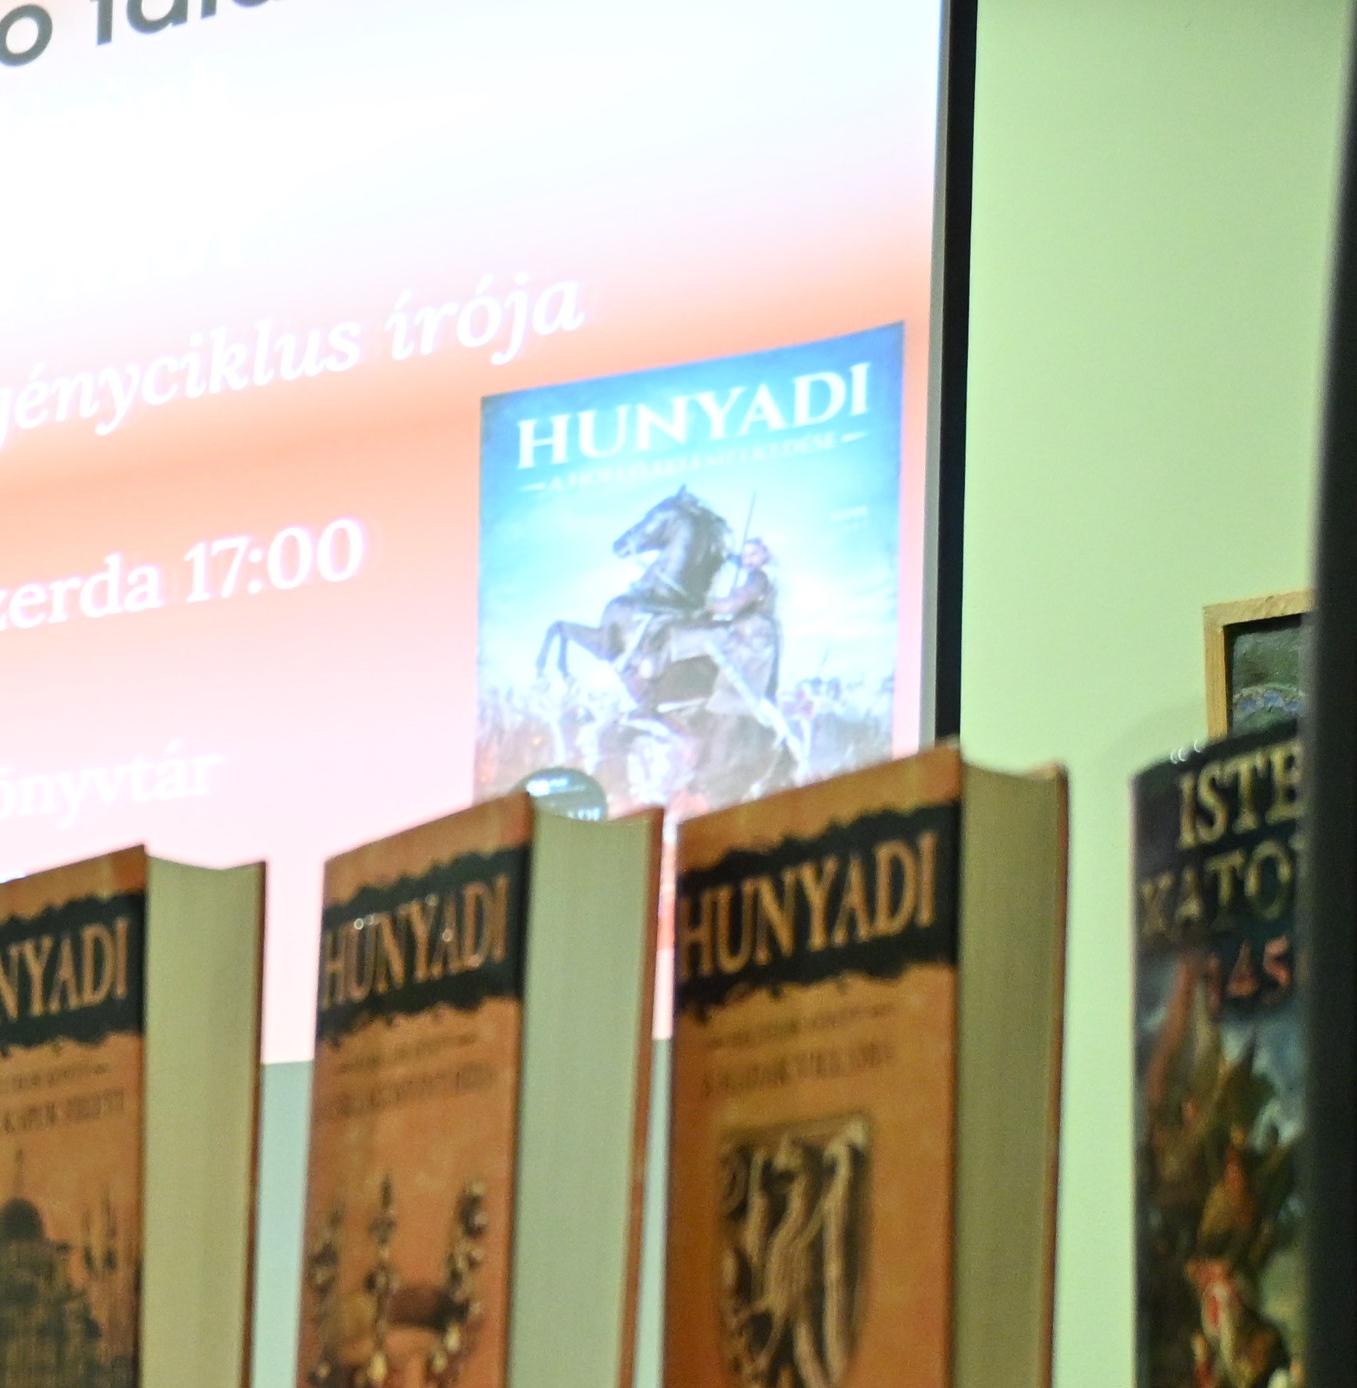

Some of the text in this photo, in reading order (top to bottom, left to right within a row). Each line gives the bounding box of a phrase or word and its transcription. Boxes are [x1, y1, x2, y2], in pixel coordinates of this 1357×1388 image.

[384, 272, 585, 365] írója
[517, 362, 871, 470] HUNYADI
[183, 517, 366, 604] 17:00
[323, 873, 511, 1010] HUNYADI
[677, 831, 937, 980] HUNYADI
